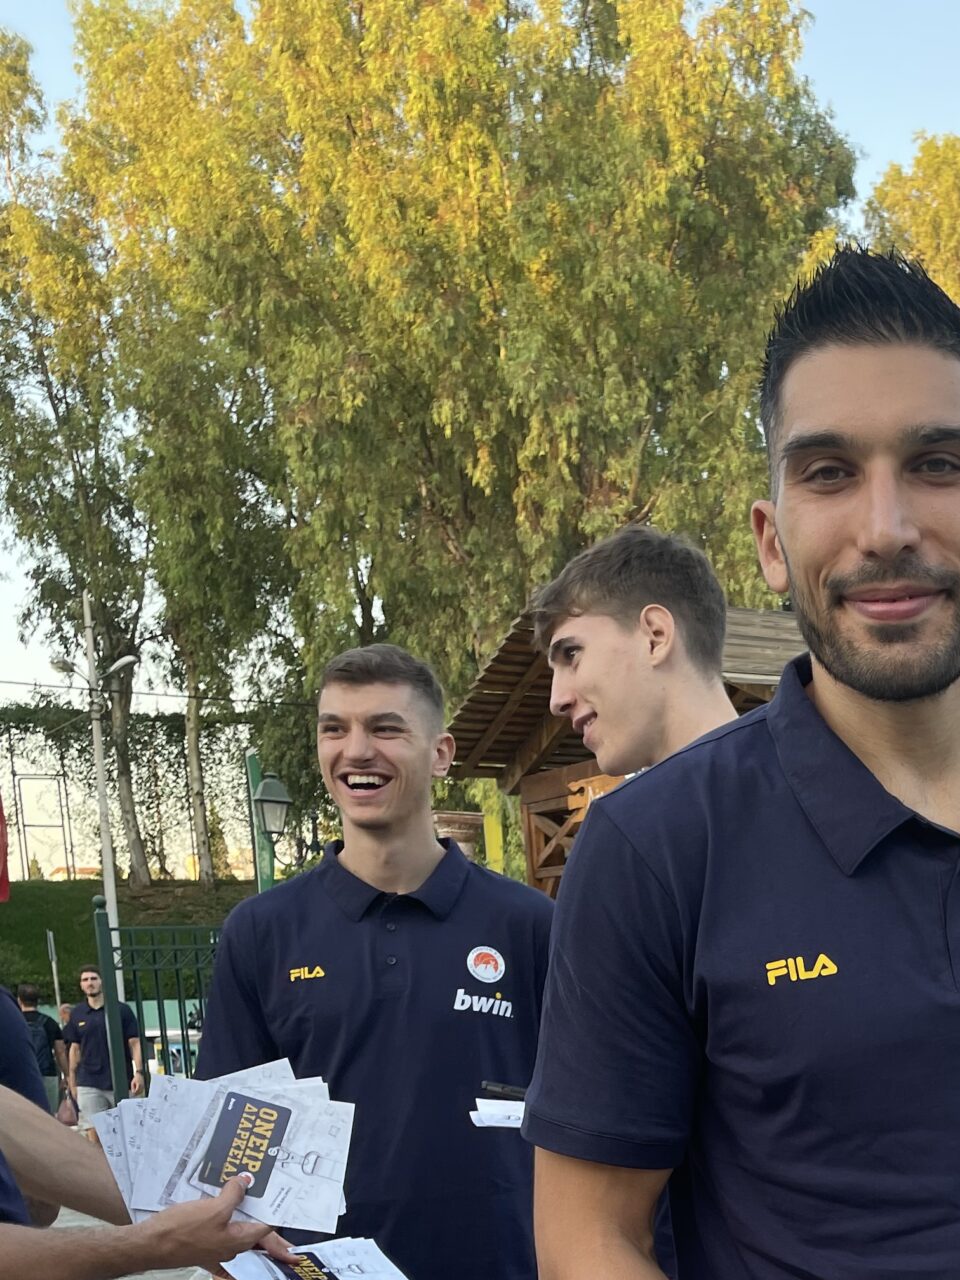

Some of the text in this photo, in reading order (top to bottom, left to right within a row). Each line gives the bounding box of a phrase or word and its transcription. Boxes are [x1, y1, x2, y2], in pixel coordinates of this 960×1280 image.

[289, 966, 325, 982] FILA
[765, 953, 838, 985] FILA
[453, 988, 513, 1018] bwin
